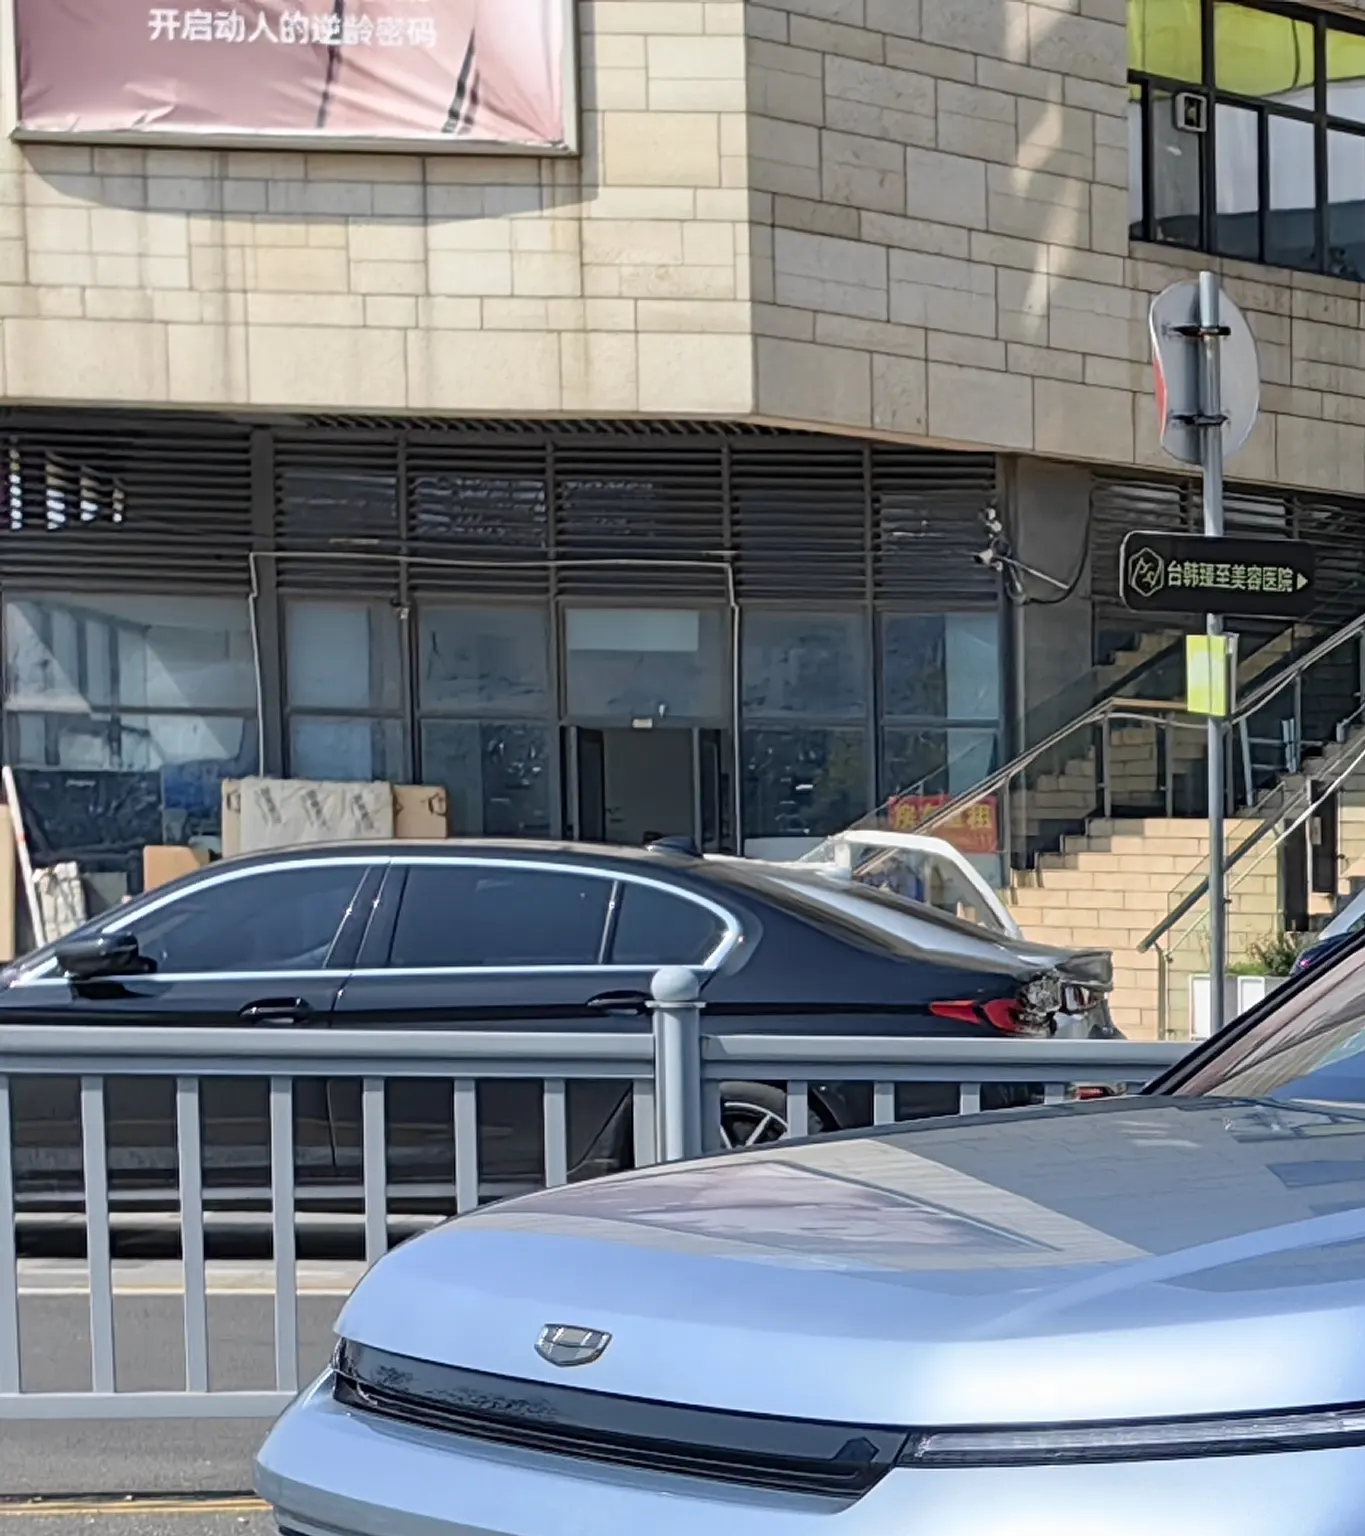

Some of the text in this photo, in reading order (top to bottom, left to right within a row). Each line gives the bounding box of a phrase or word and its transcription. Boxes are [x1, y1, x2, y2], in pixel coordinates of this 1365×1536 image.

[147, 9, 437, 48] 开启动人的逆龄密码
